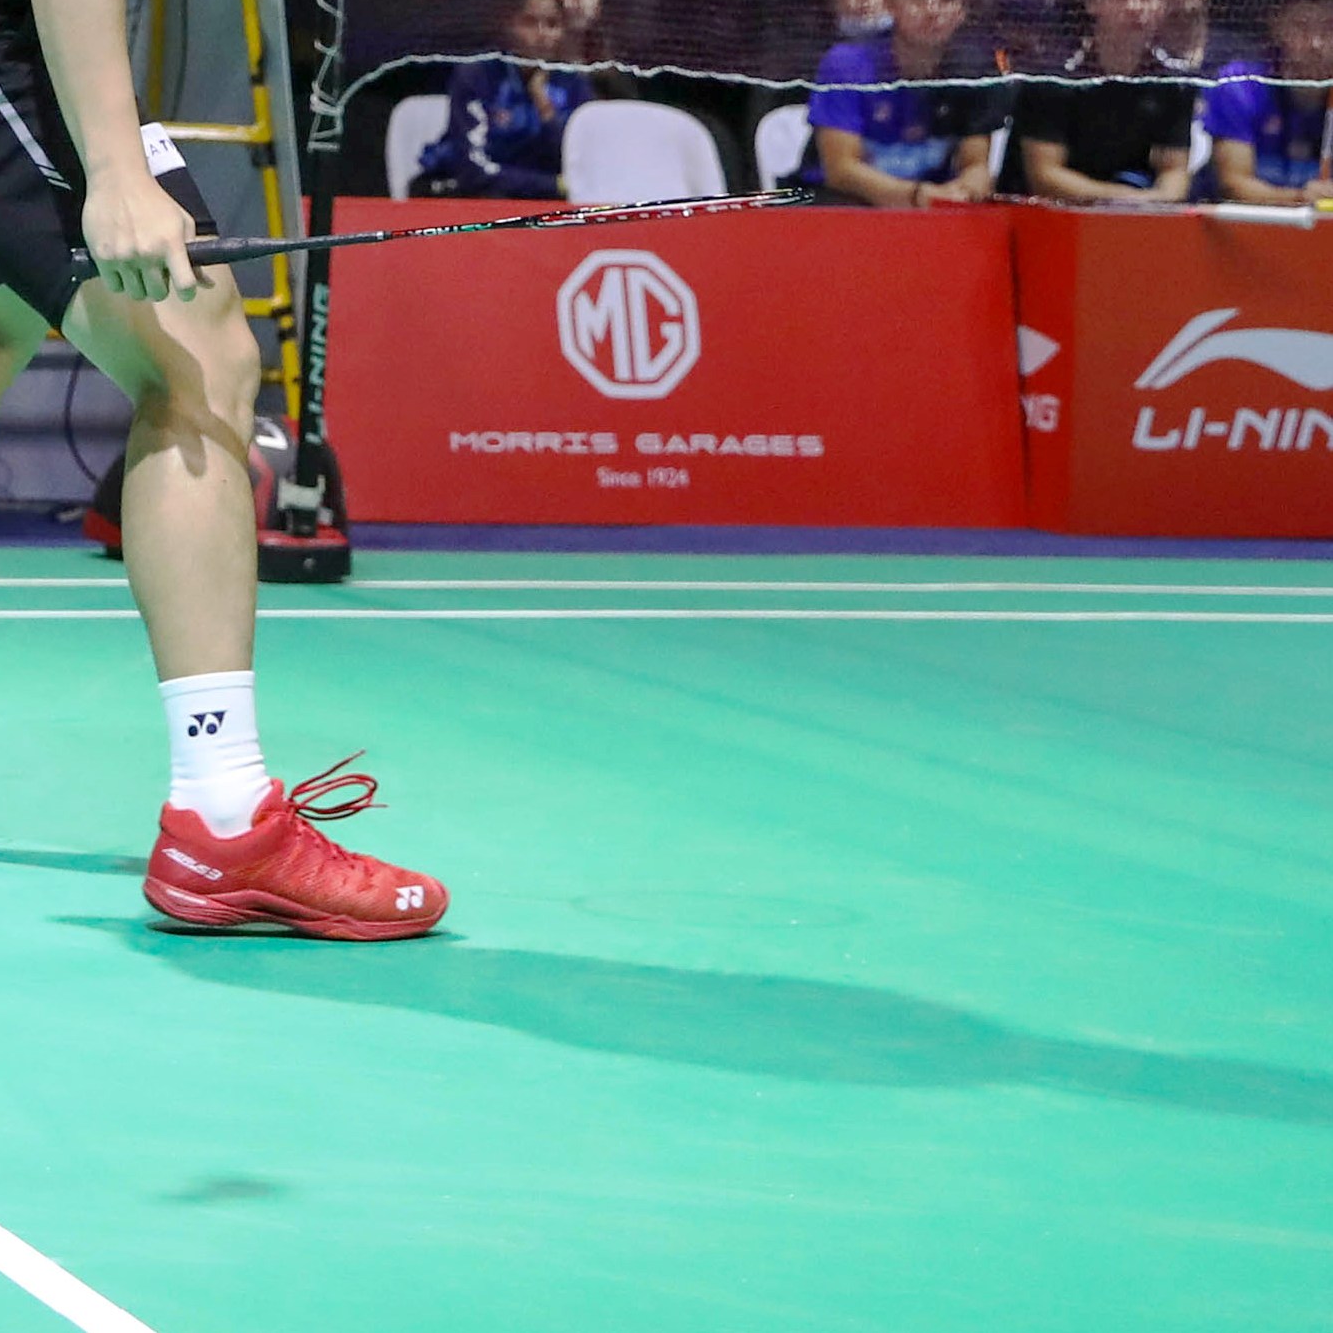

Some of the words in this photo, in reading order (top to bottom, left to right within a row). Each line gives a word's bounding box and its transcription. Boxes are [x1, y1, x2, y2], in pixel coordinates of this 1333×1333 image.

[572, 265, 684, 381] MG
[449, 431, 620, 455] MORRIS
[634, 432, 825, 457] GARAGES
[596, 467, 642, 488] Since
